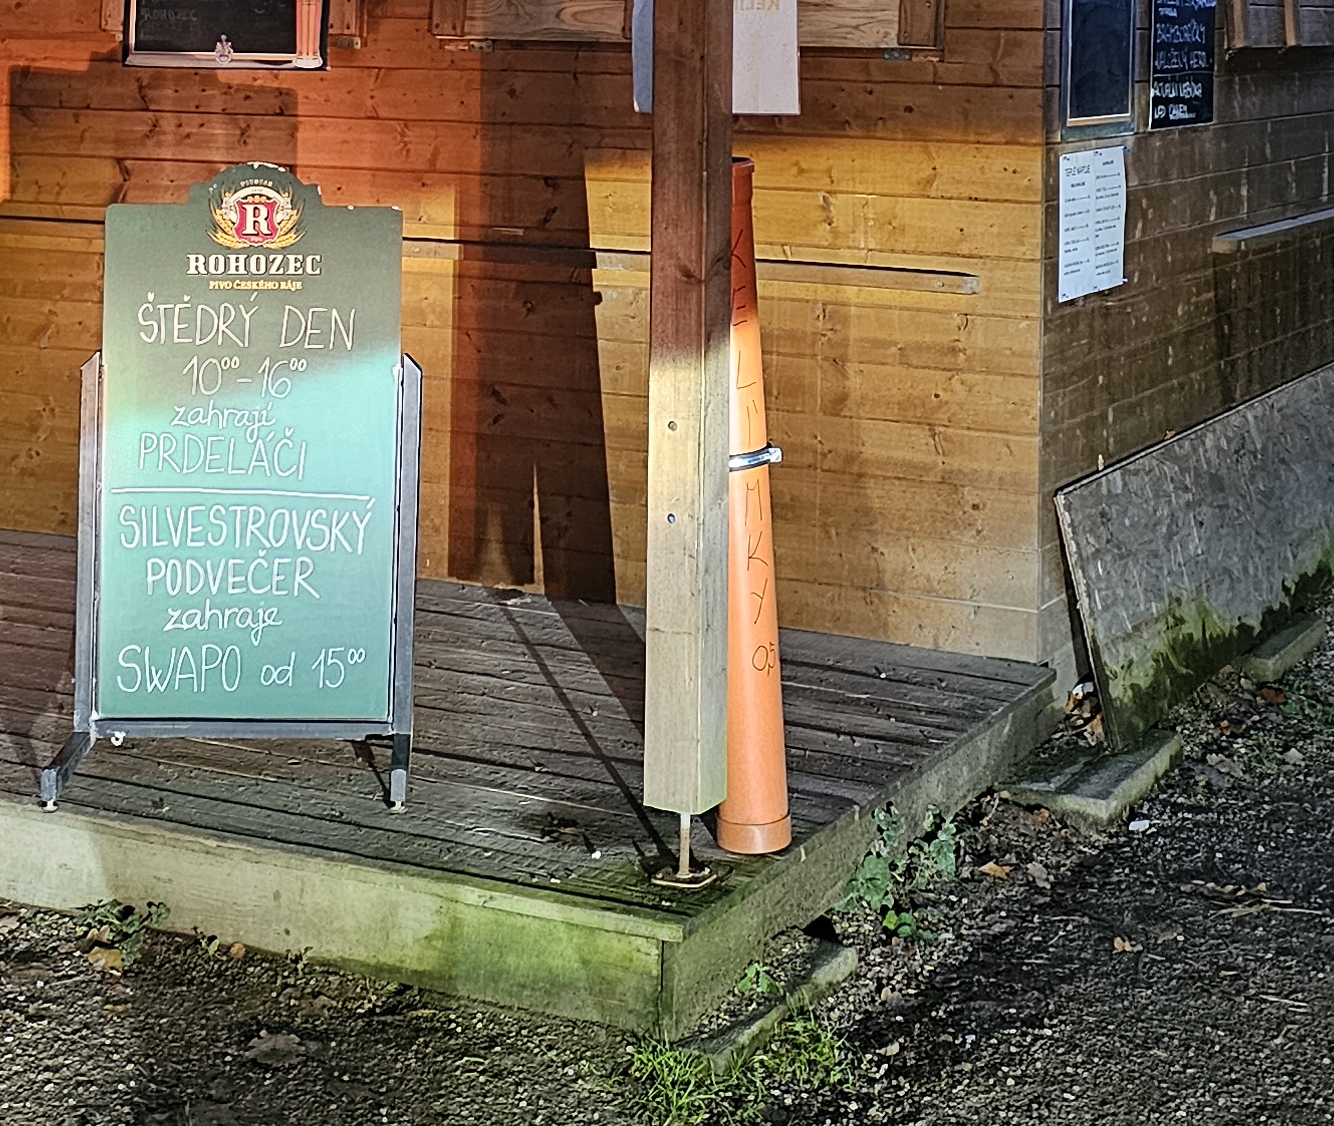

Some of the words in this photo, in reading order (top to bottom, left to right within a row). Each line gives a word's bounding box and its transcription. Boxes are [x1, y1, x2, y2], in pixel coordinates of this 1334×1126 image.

[242, 205, 272, 235] R
[186, 254, 322, 276] ROHOZEC
[209, 281, 232, 290] PIVO
[233, 279, 279, 290] ČESKÉHO
[137, 291, 260, 349] ŠTĚDRÝ
[279, 304, 356, 351] DEN
[171, 400, 276, 443] zahrají
[139, 427, 307, 480] PRDELÁČI
[119, 497, 376, 555] SILVESTROVSKÝ
[146, 549, 320, 599] PODVEČER
[163, 599, 284, 646] zahraje
[117, 644, 241, 693] SWAPO
[260, 651, 296, 687] od
